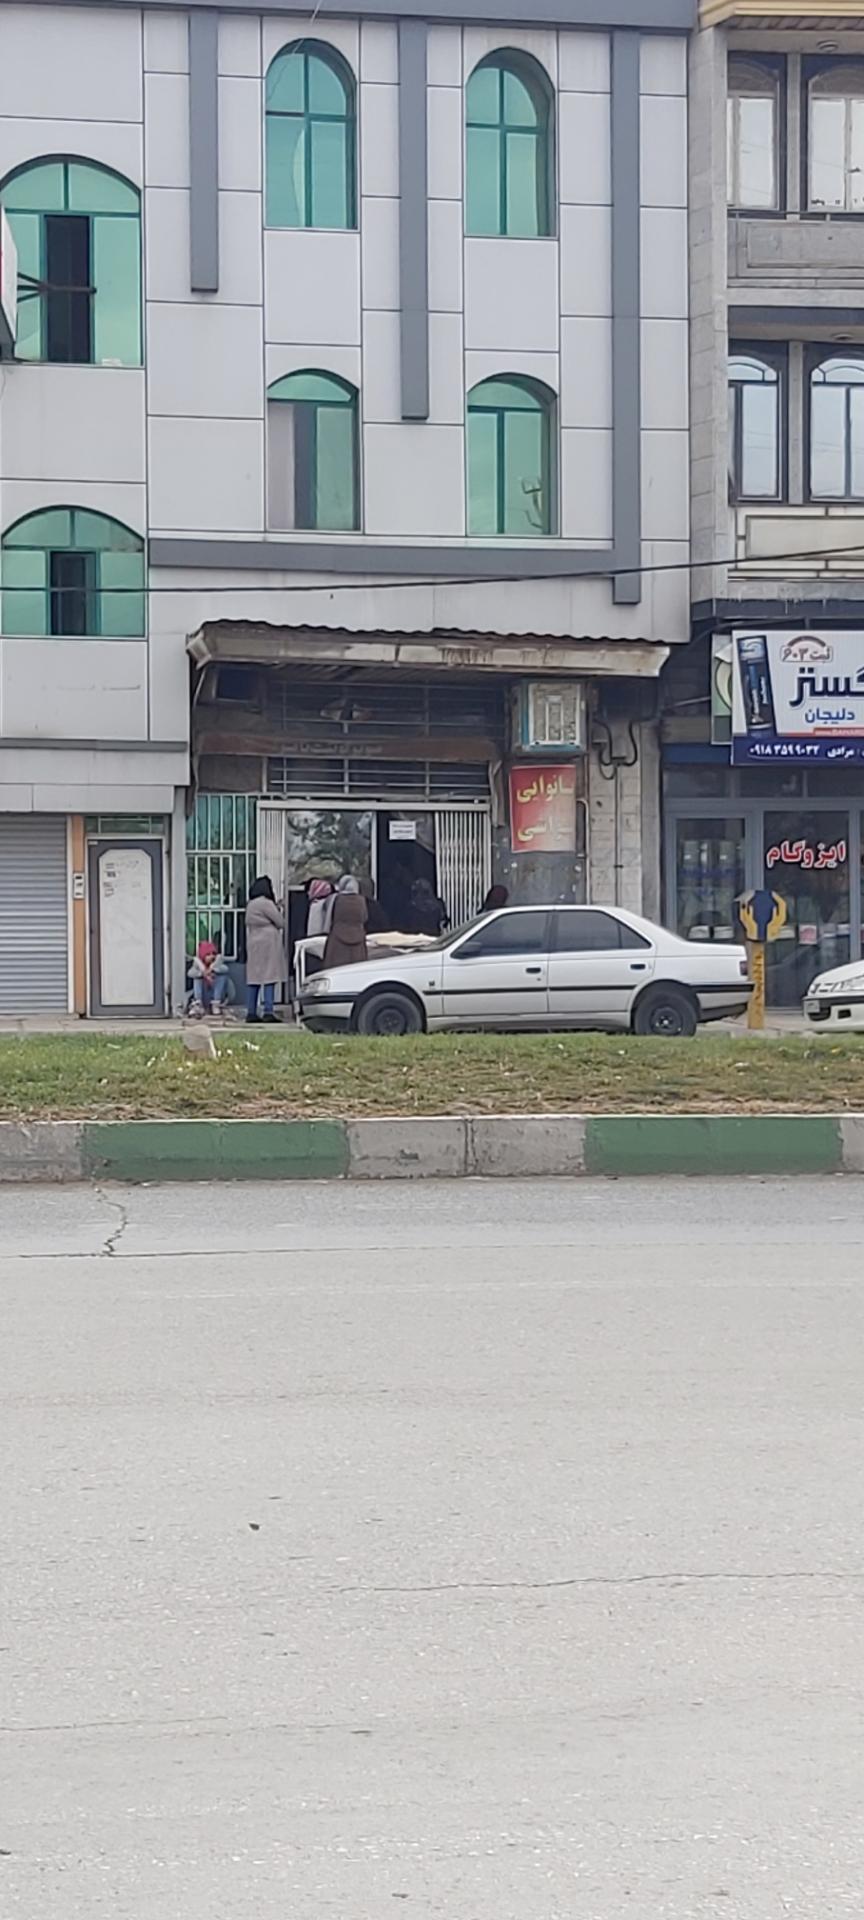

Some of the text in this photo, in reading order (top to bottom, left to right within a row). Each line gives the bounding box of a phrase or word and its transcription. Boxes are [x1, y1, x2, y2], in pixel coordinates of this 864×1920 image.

[804, 707, 855, 725] دلیجان
[826, 745, 855, 759] مرادی
[766, 840, 847, 869] ایزوگام
